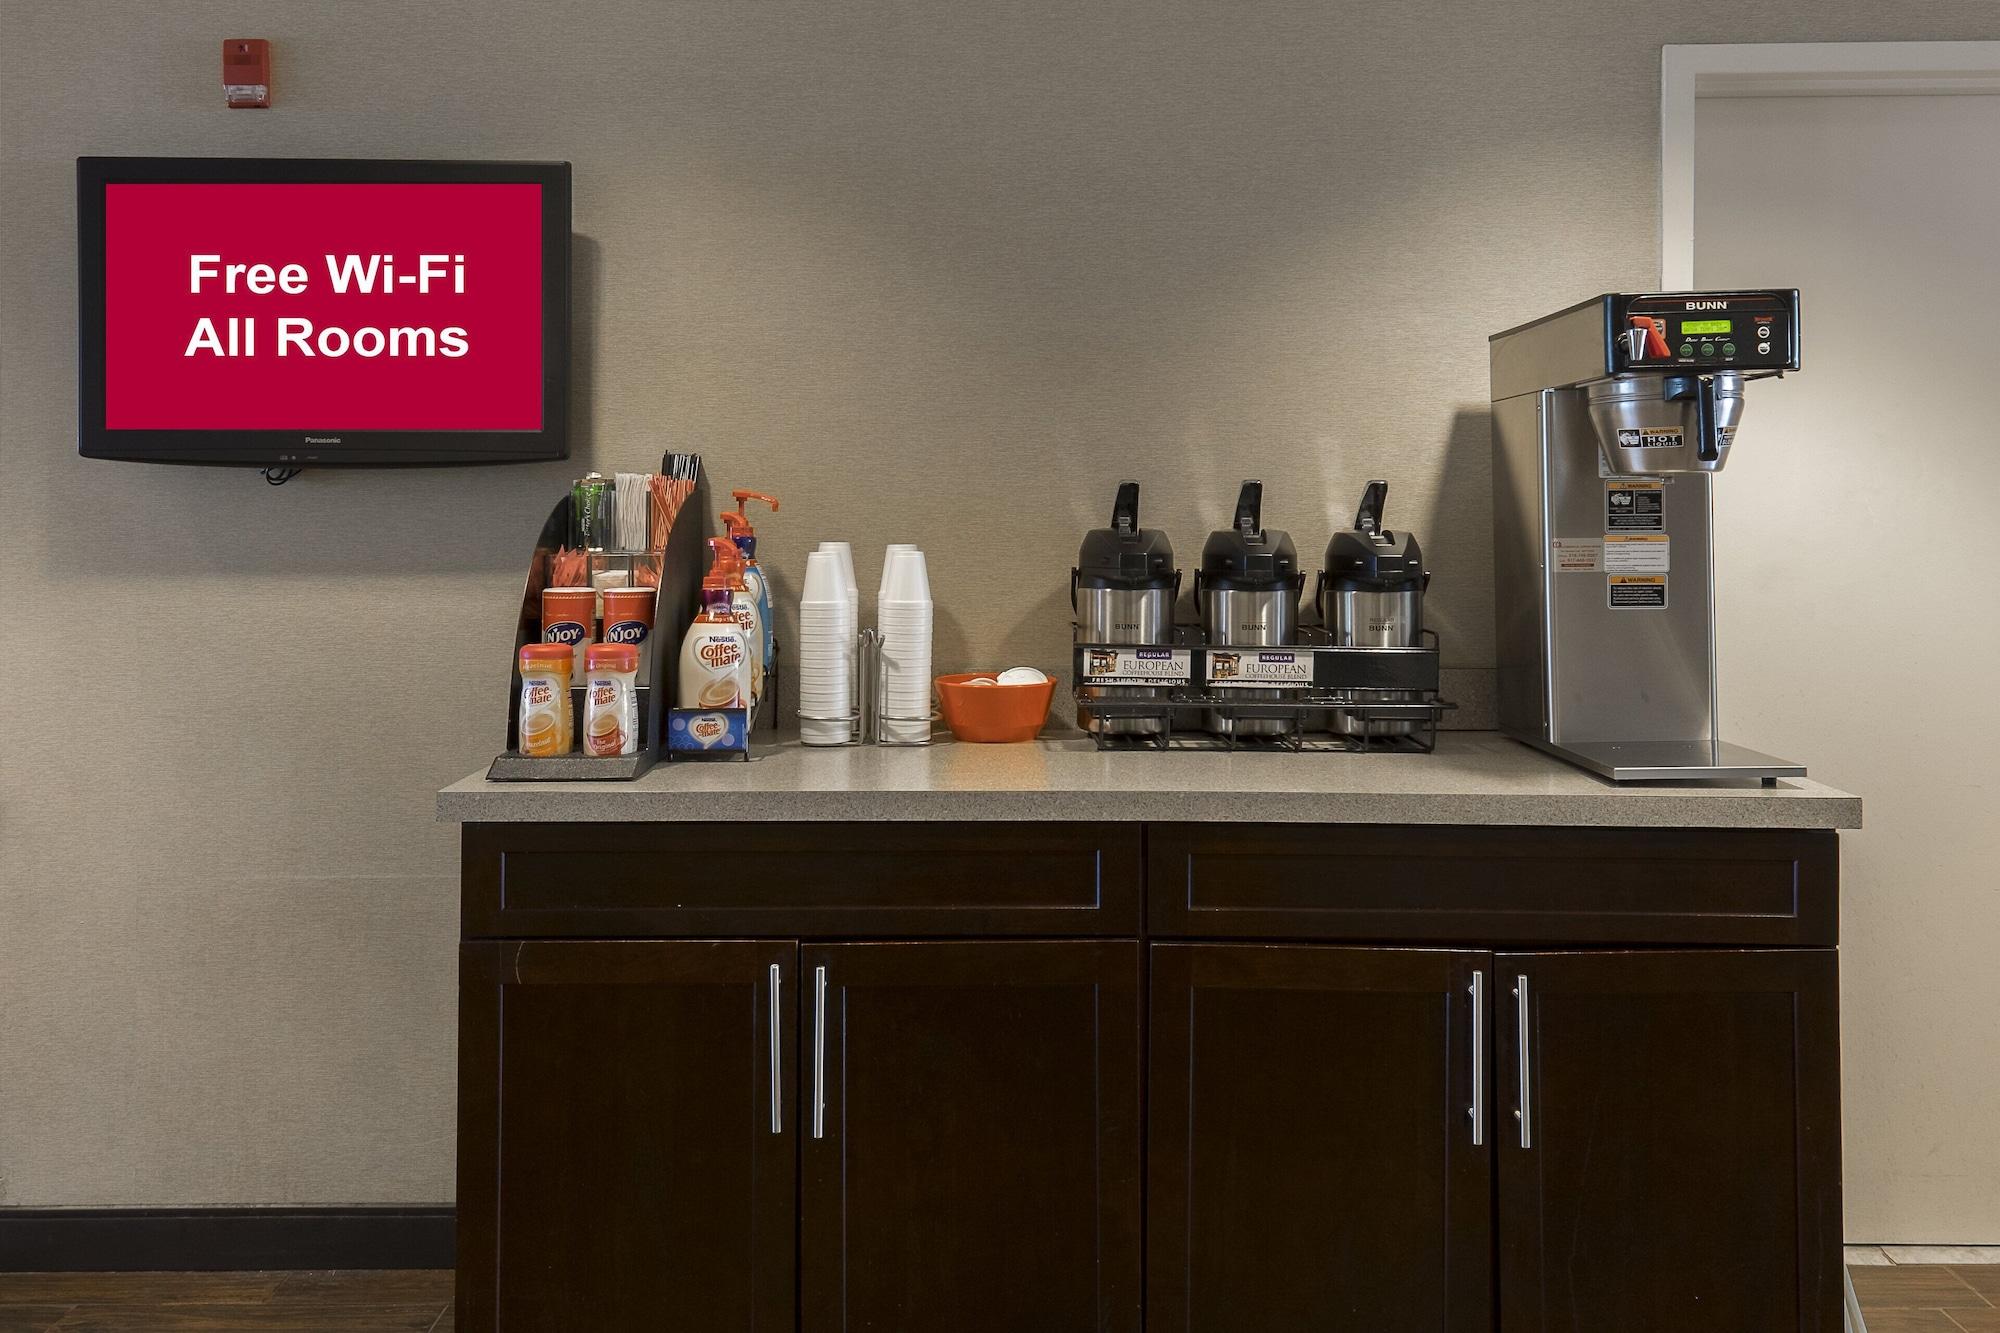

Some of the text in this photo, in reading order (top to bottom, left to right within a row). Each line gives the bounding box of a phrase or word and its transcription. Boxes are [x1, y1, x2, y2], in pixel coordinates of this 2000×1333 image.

[190, 254, 465, 295] Free Wi-Fi
[1685, 301, 1727, 311] BUNN
[184, 317, 469, 358] All Rooms
[304, 436, 342, 444] Panasonic
[1114, 623, 1140, 631] BUNN
[711, 654, 741, 667] mate
[1123, 660, 1184, 671] EUROPEAN
[1246, 664, 1307, 674] EUROPEAN
